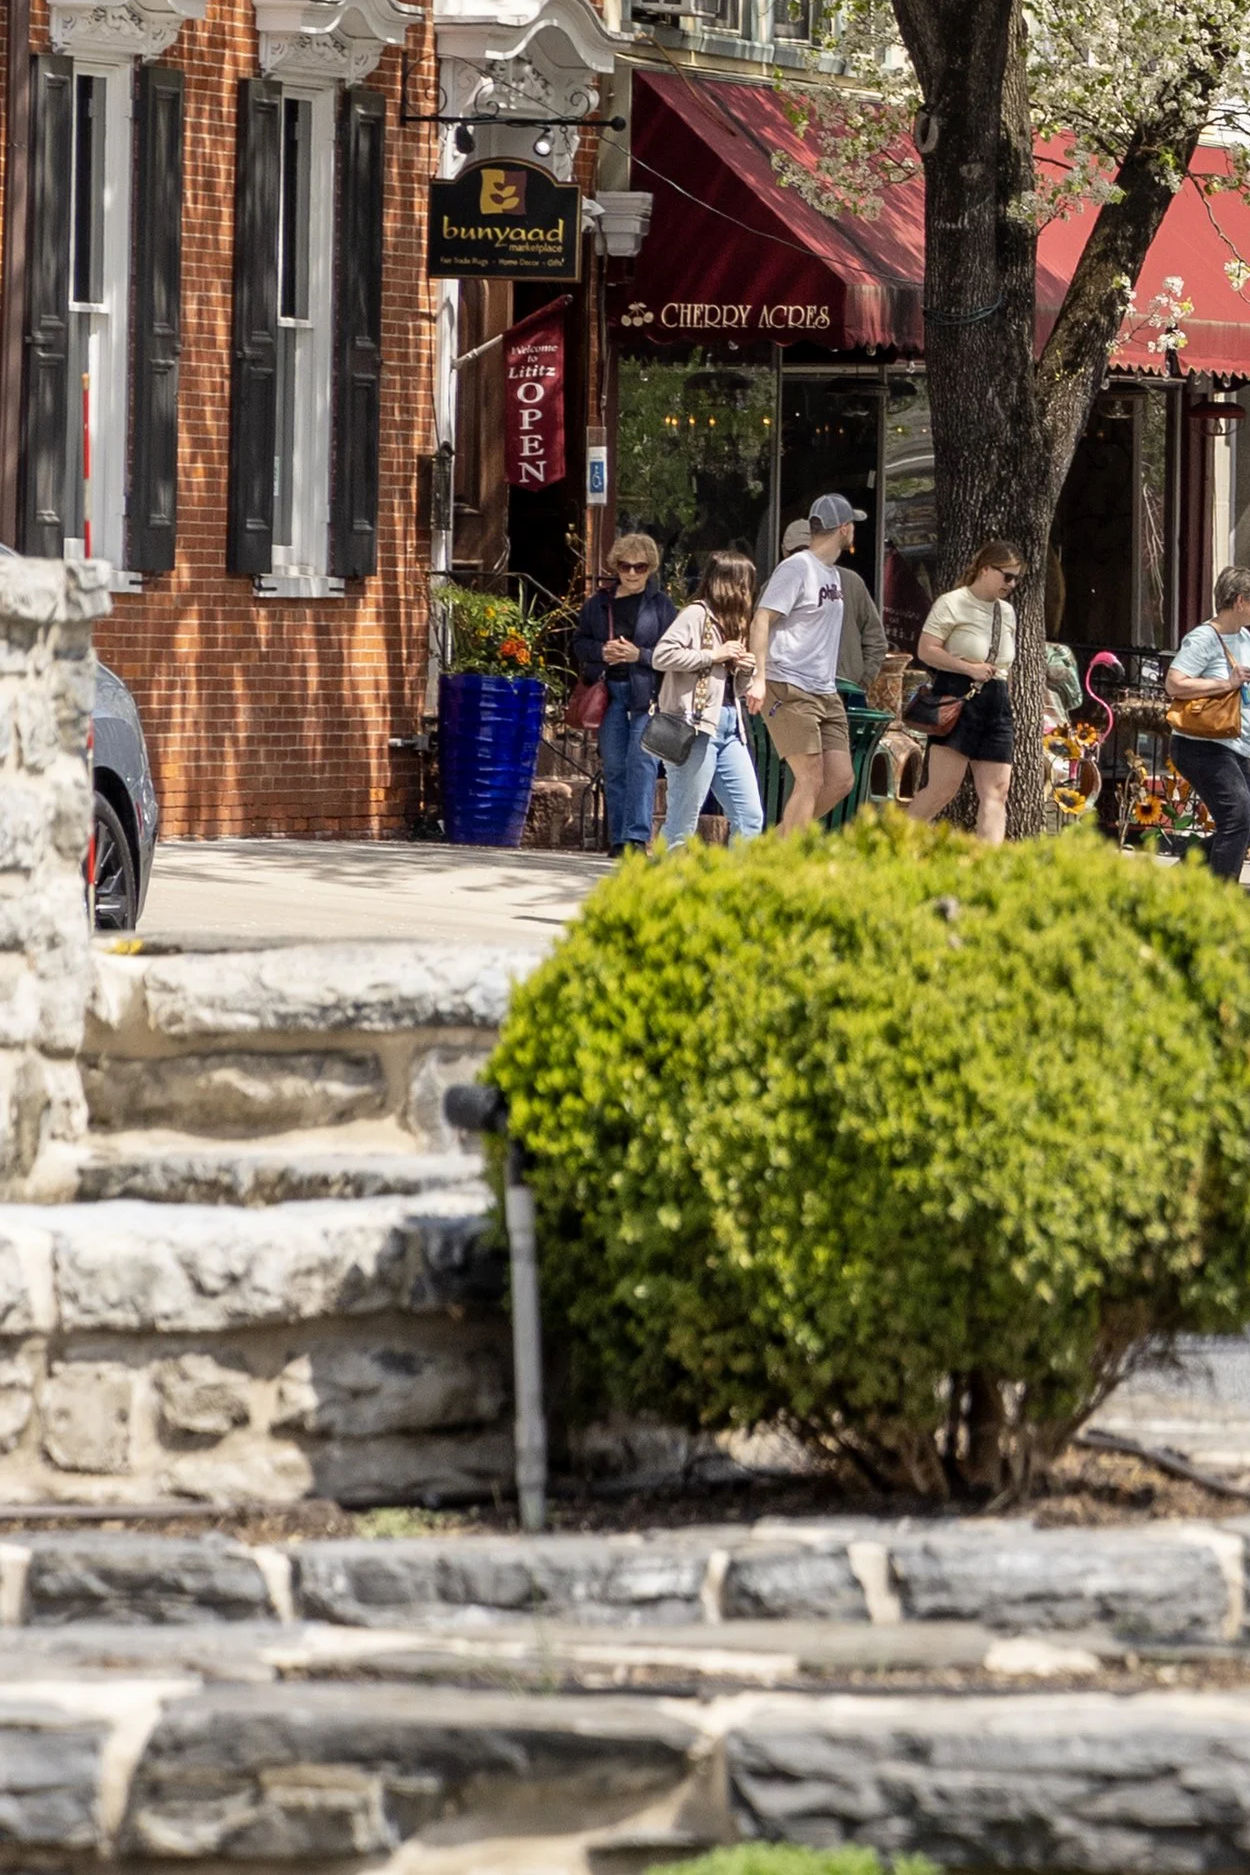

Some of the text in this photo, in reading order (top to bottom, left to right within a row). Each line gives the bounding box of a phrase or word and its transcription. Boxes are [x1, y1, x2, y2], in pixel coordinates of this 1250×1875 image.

[443, 215, 564, 247] bunyaad
[509, 242, 563, 254] marketplace
[661, 302, 831, 329] CHERRY ACRES
[511, 344, 559, 355] Welcome
[527, 355, 538, 363] to
[508, 365, 556, 378] Lititz
[516, 382, 547, 483] OPEN
